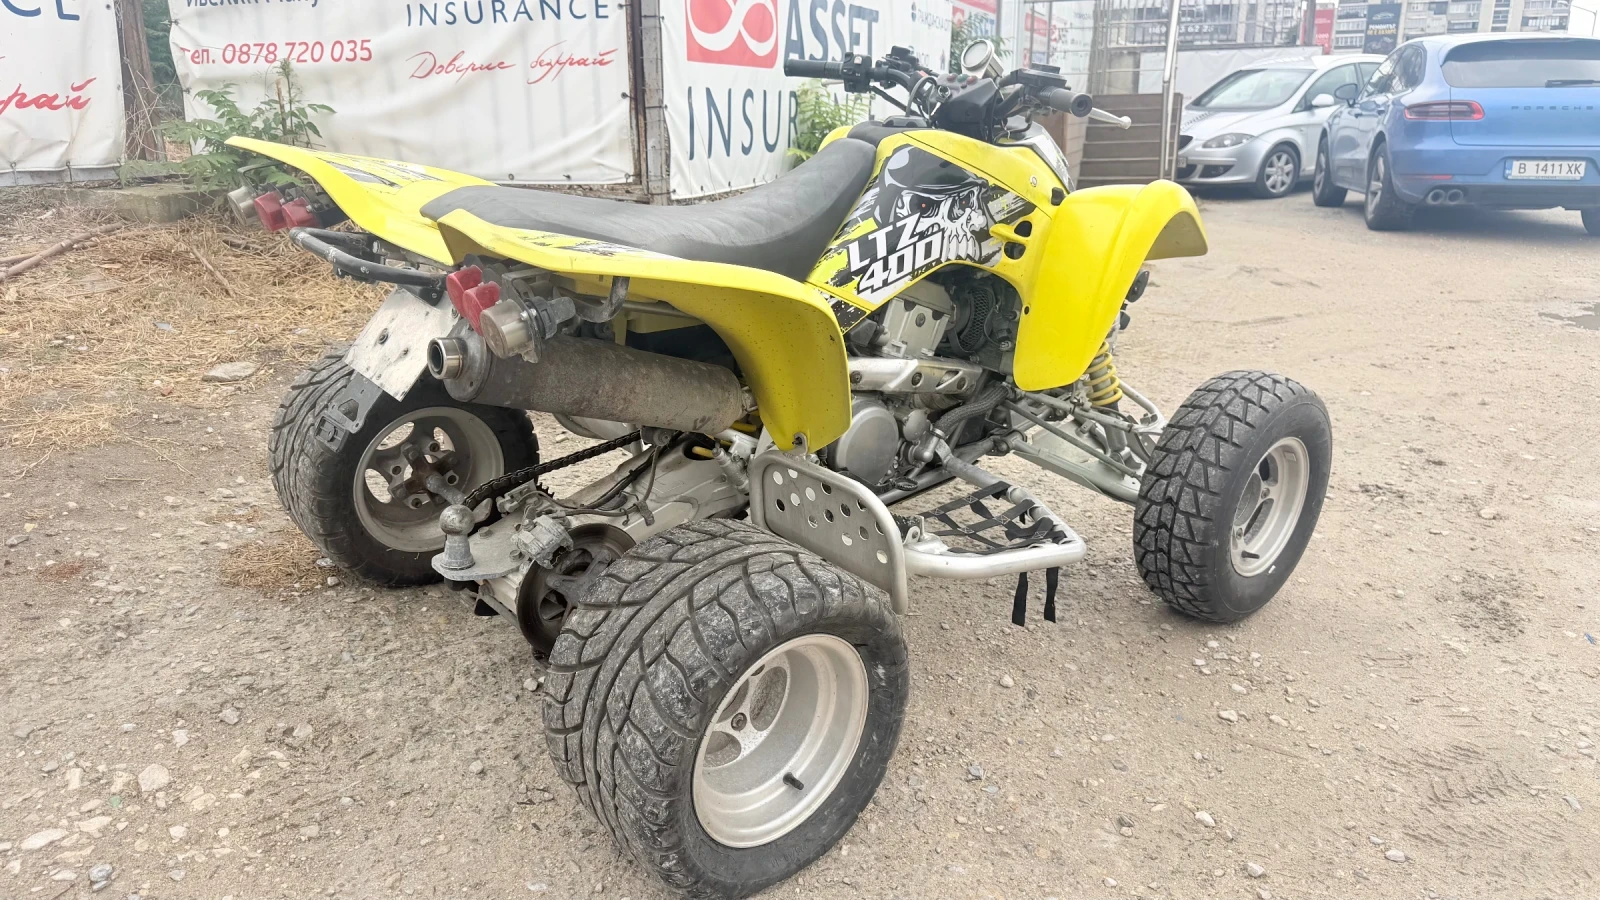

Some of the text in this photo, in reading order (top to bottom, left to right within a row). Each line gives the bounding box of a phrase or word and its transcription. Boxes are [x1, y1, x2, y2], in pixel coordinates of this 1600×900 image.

[405, 0, 609, 27] INSURANCE
[784, 0, 879, 67] ASSET
[222, 43, 278, 64] 0878
[285, 41, 324, 63] 720
[330, 39, 372, 62] 035
[1518, 162, 1527, 174] B
[848, 212, 922, 272] LTZ
[857, 230, 945, 293] 400
